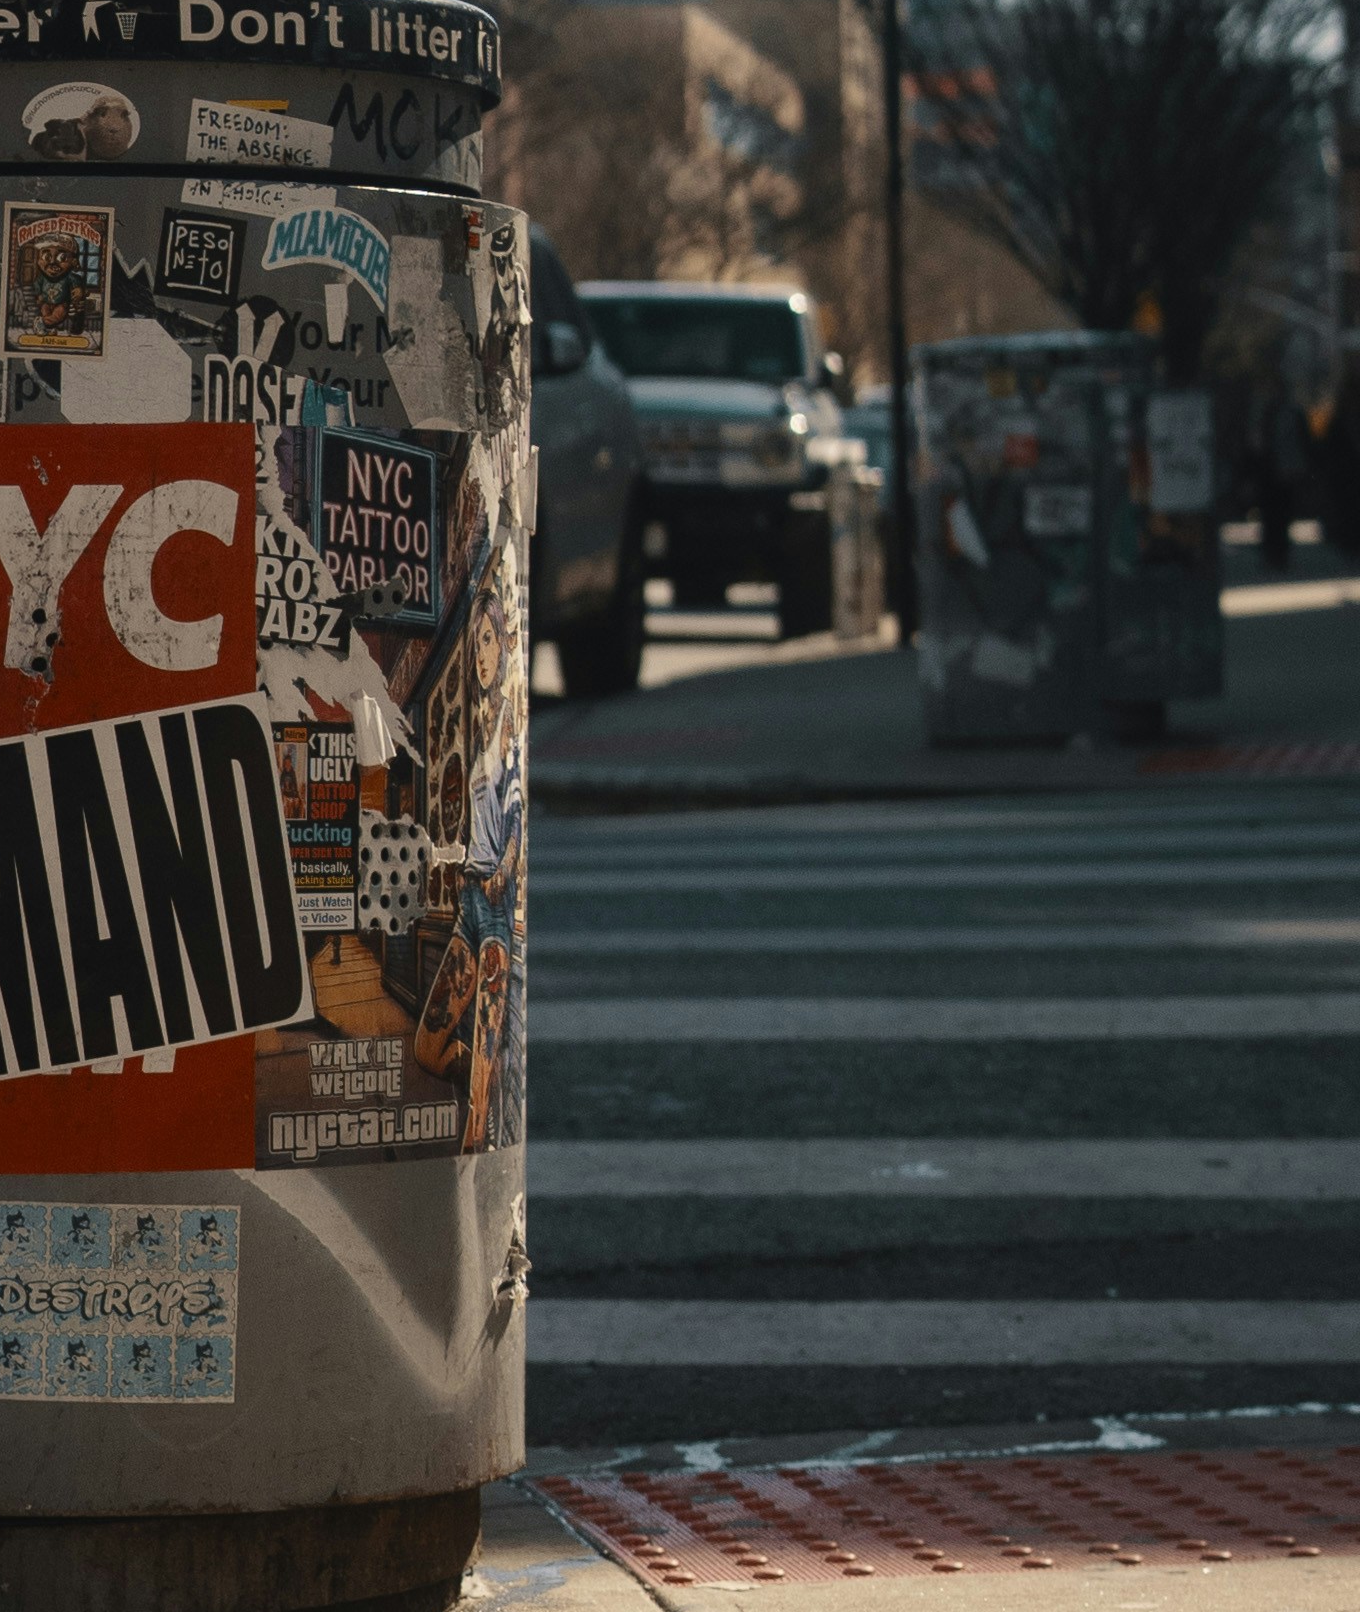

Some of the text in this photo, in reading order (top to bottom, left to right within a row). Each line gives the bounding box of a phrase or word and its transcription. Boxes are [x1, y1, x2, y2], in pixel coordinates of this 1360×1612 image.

[371, 6, 462, 63] litter
[197, 107, 290, 141] FREEDOM:
[197, 132, 228, 152] THE
[347, 448, 413, 509] NYC
[323, 501, 430, 559] TATTOO
[309, 757, 354, 783] UGLY
[310, 783, 357, 800] TATTOO
[310, 801, 348, 820] SHOP
[300, 861, 351, 876] basically,
[326, 875, 354, 887] stupid
[297, 896, 352, 908] Just Watch
[309, 1039, 371, 1071] WALK
[310, 1070, 403, 1100] WELCOME
[271, 1104, 458, 1159] nyctat.com
